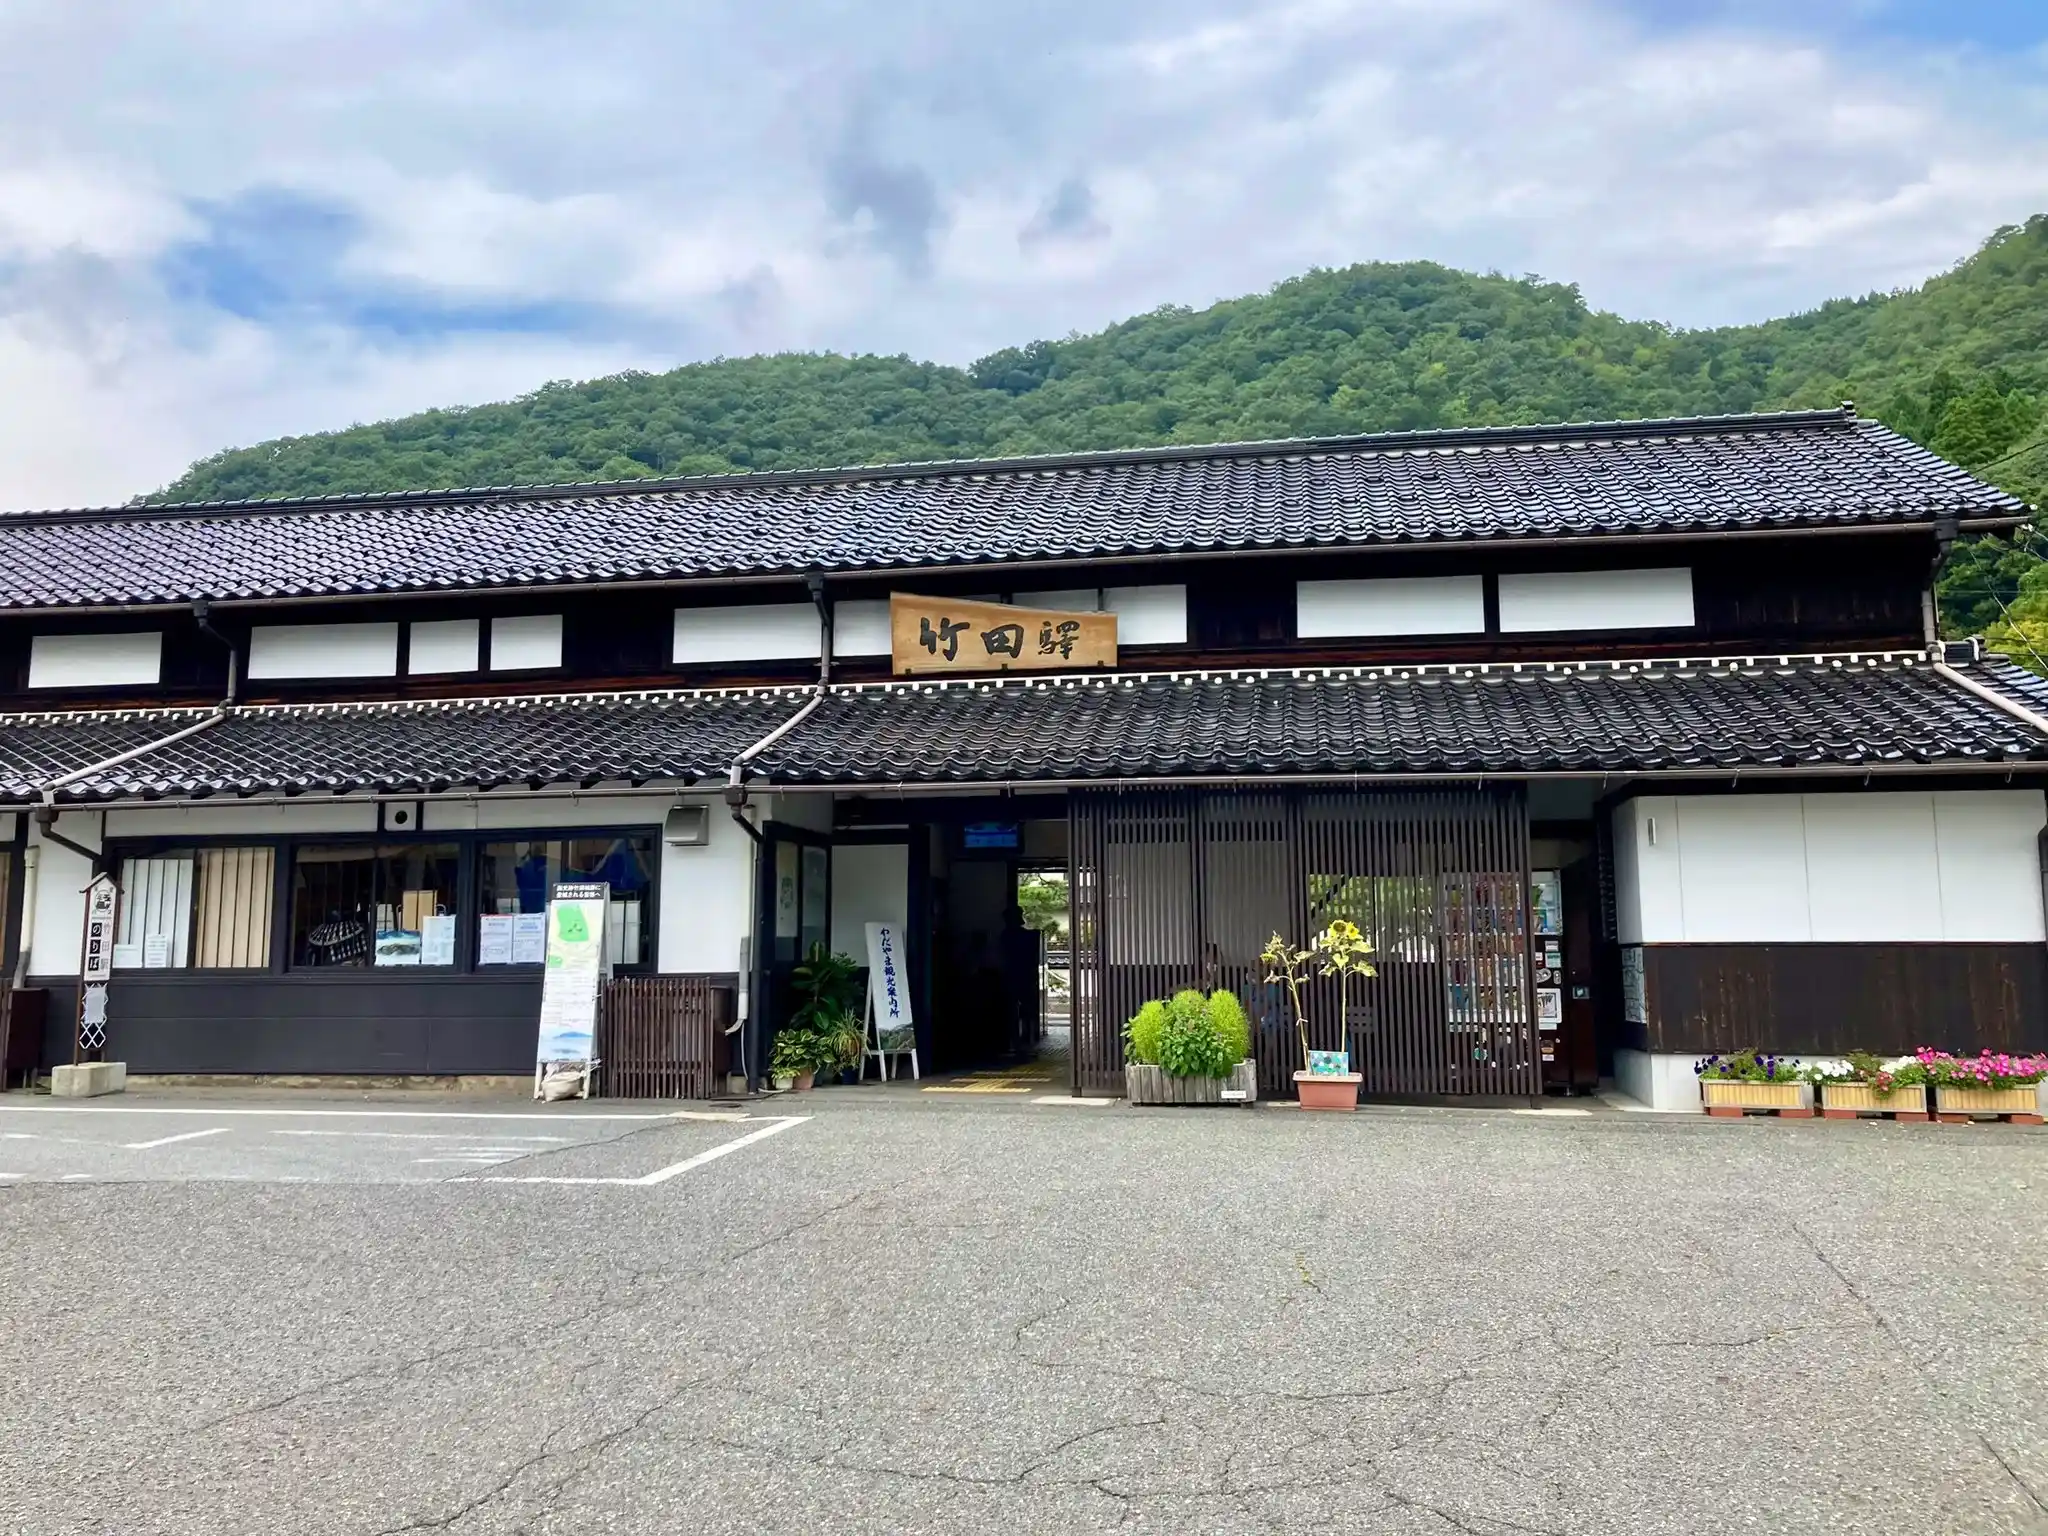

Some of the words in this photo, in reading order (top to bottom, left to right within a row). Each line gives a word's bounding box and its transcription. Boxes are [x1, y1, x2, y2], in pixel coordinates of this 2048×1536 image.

[919, 617, 1081, 661] 竹田驛
[89, 924, 102, 970] のりば
